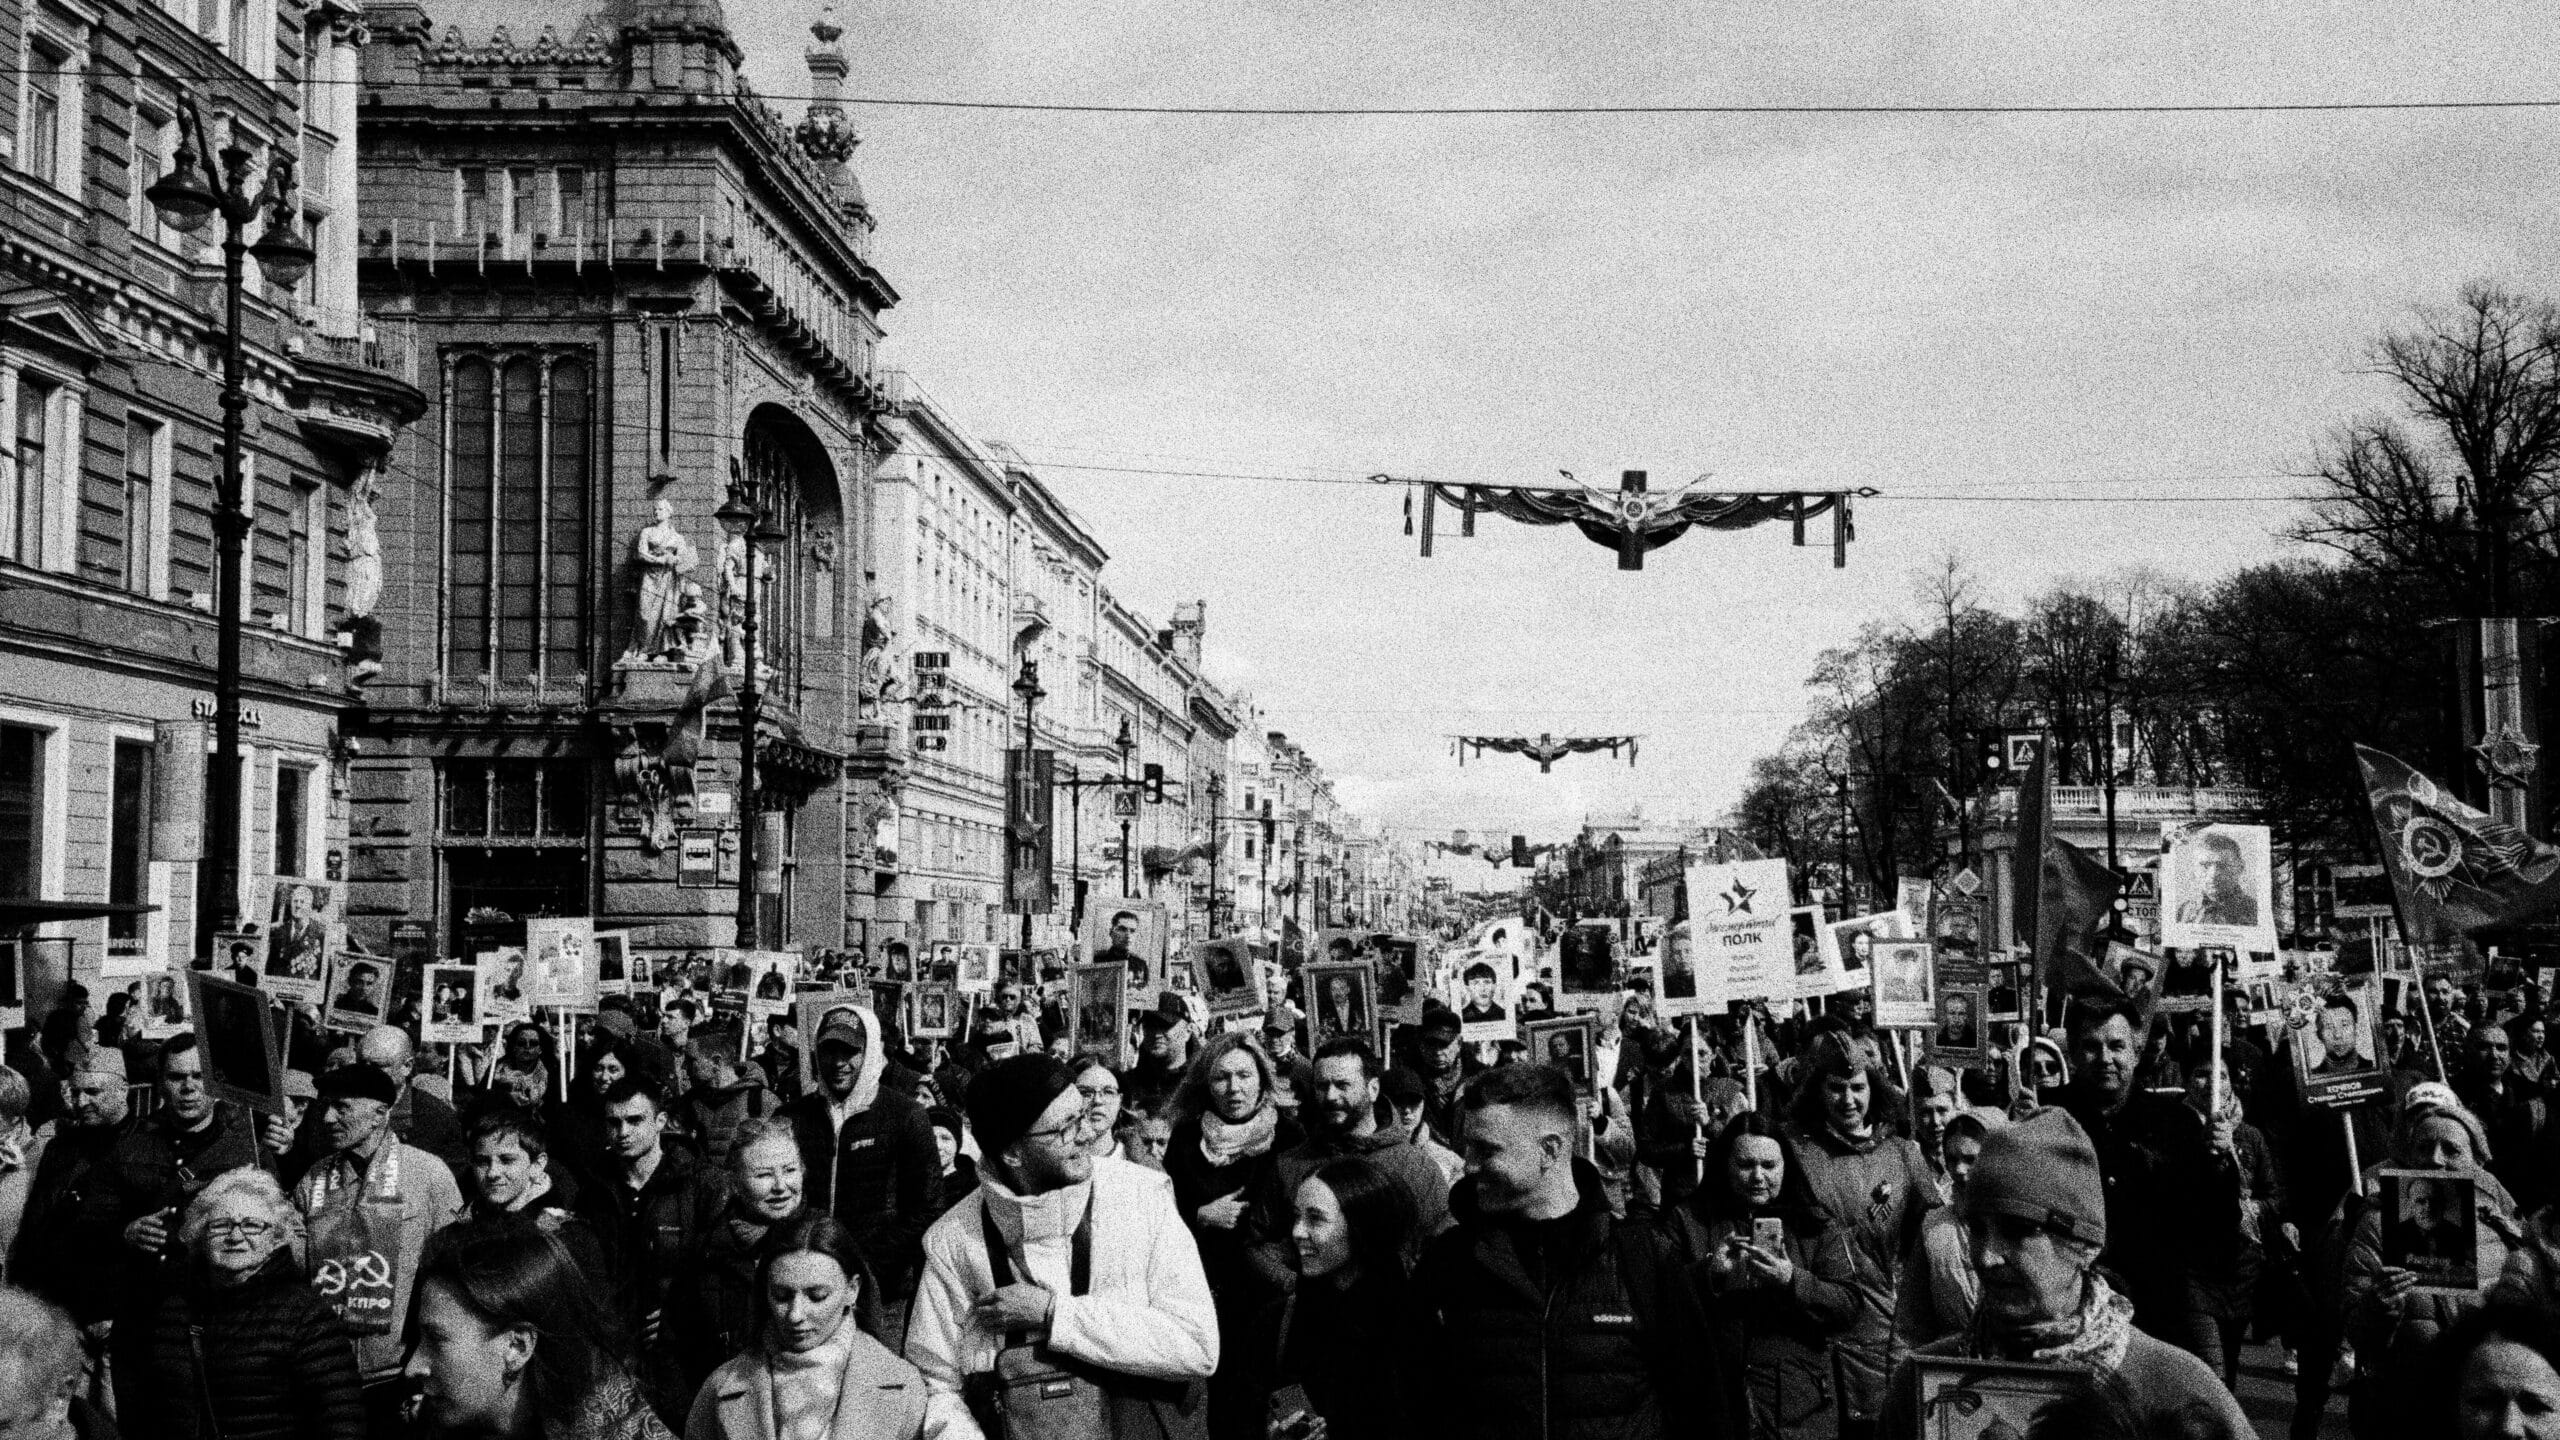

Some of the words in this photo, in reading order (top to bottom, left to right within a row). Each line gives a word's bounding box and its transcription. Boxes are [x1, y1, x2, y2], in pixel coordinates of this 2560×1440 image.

[2128, 906, 2157, 917] СТОП
[1723, 932, 1763, 947] ПОЛК
[347, 1297, 391, 1310] КПРФ
[1593, 1314, 1623, 1324] adidas
